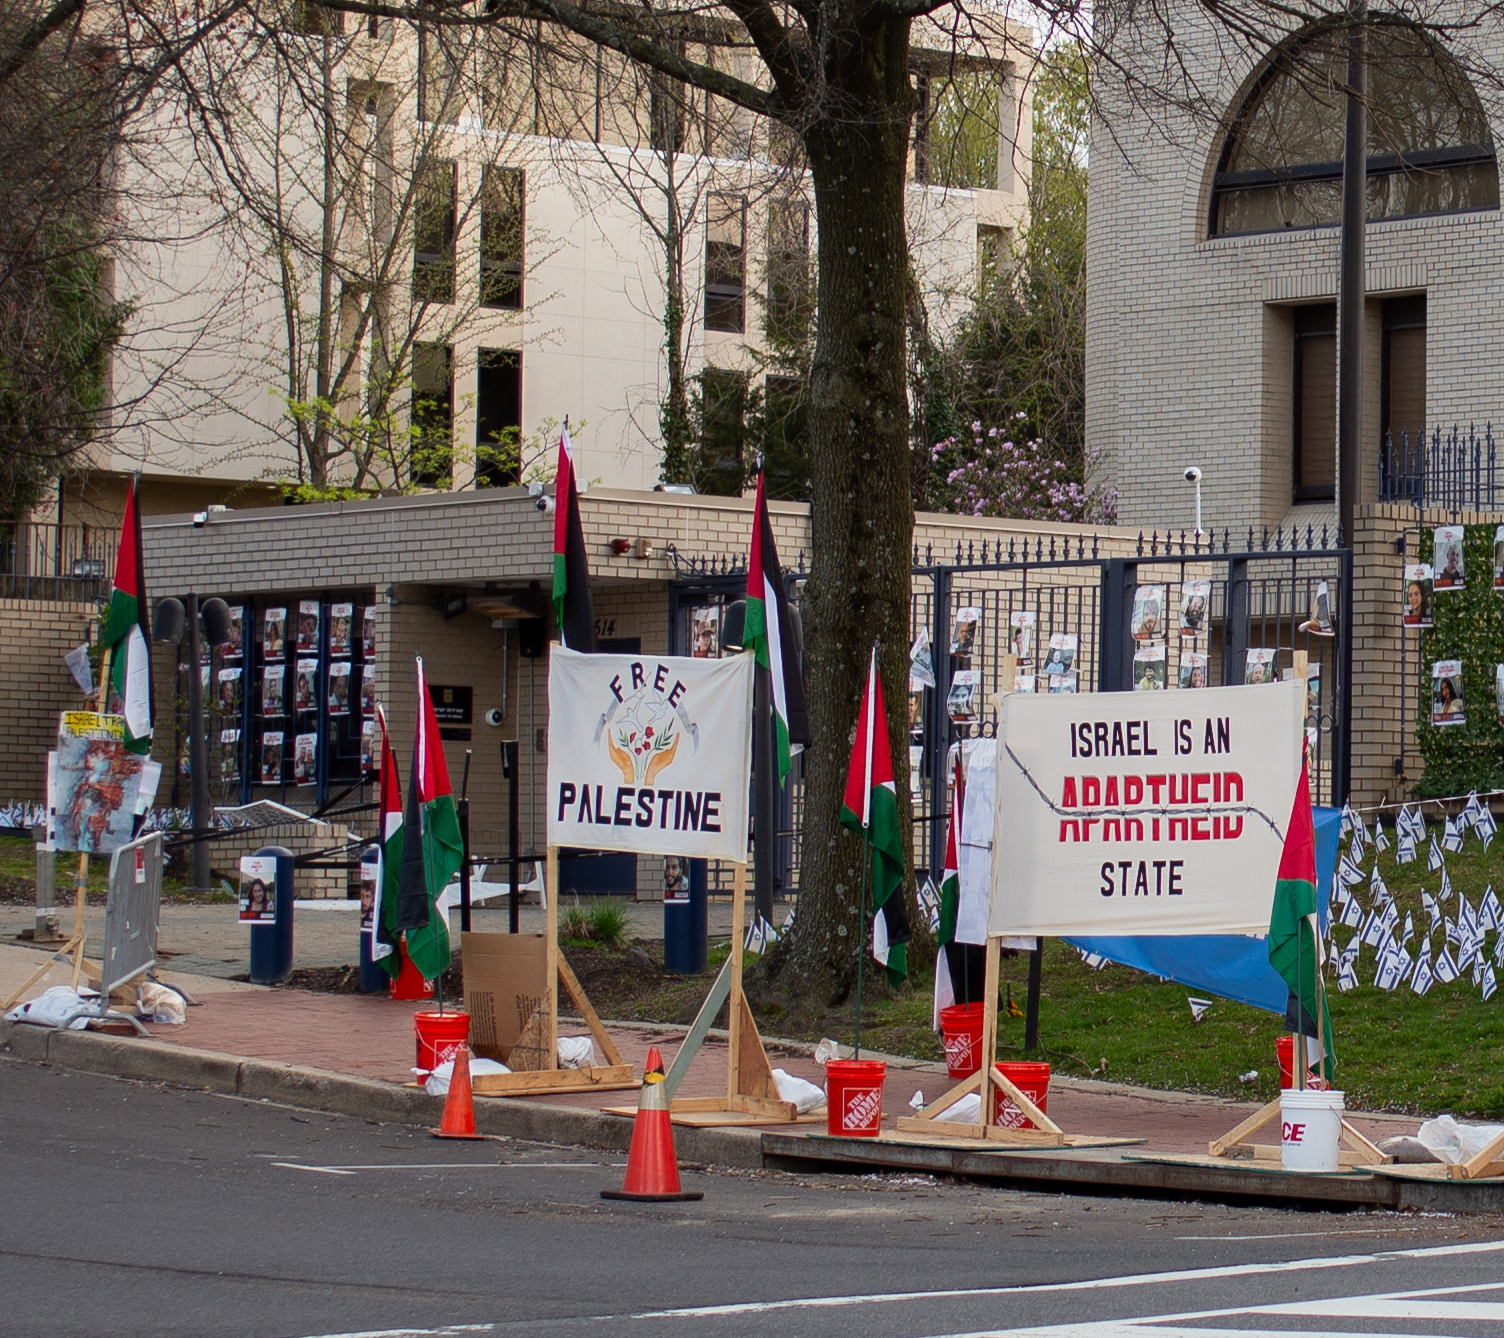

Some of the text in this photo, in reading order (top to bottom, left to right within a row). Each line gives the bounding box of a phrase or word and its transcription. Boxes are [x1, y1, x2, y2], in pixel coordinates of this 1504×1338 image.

[609, 661, 687, 709] FREE
[1070, 717, 1230, 757] ISRAEL IS AN
[557, 782, 722, 833] PALESTINE
[1059, 771, 1244, 842] APARTHEID
[1100, 860, 1184, 897] STATE
[844, 1088, 880, 1129] HOME
[847, 1092, 866, 1109] THE
